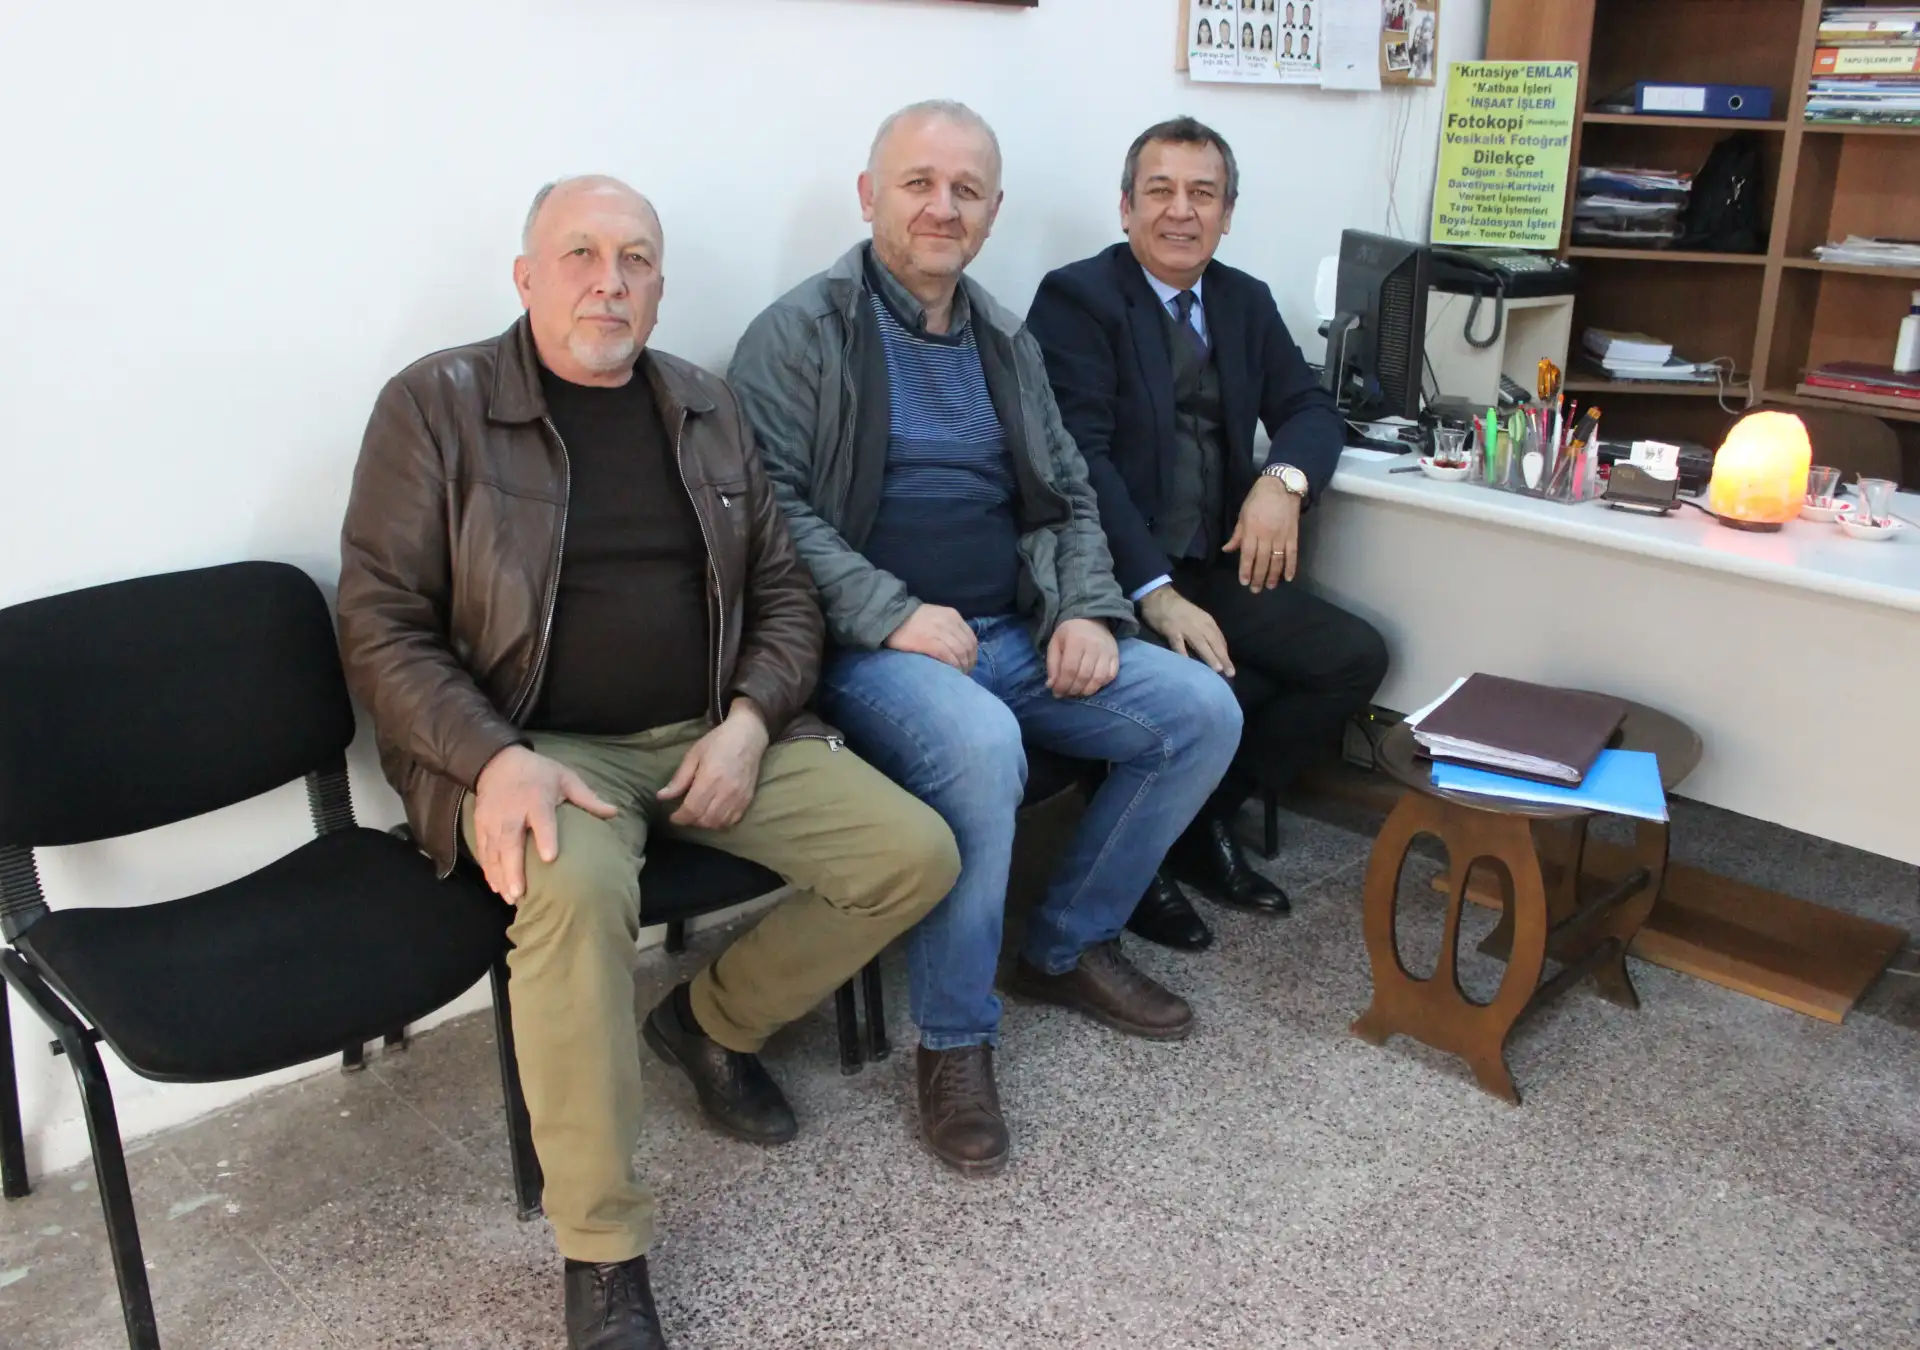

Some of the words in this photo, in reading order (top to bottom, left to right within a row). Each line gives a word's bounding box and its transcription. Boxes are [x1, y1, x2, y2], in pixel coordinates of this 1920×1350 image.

[1447, 113, 1524, 132] Fotokopi
[1446, 132, 1505, 145] Vesikalık
[1511, 134, 1569, 149] Fotoğraf
[1473, 149, 1535, 168] Dilekçe
[1450, 202, 1473, 213] Tapu
[1480, 228, 1507, 240] Toner
